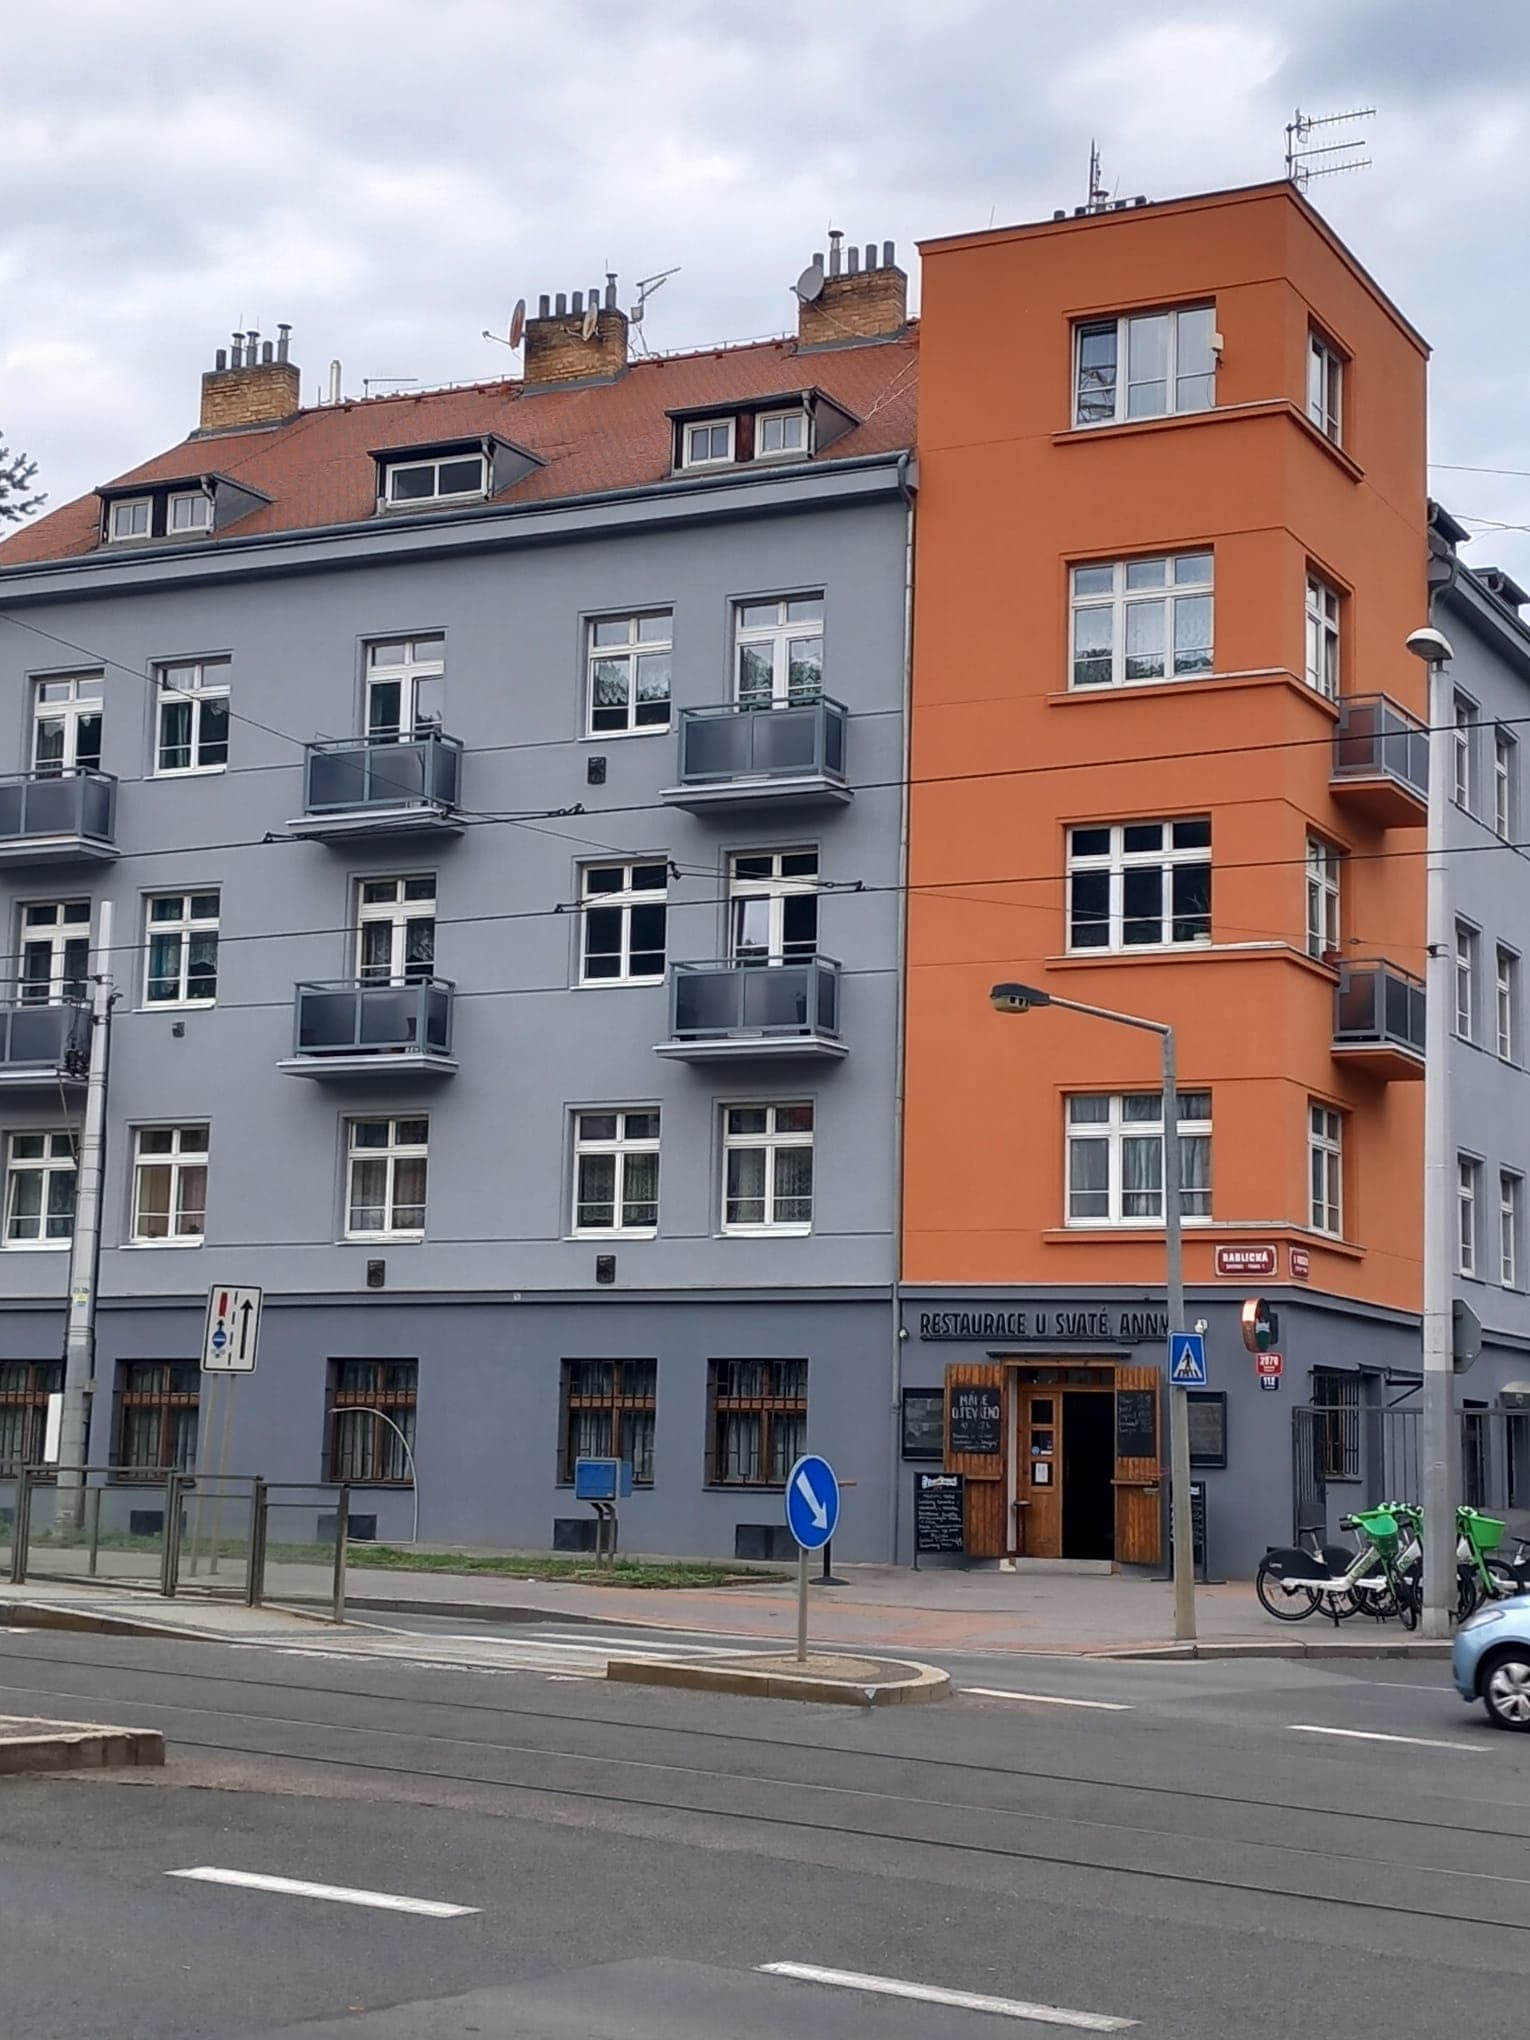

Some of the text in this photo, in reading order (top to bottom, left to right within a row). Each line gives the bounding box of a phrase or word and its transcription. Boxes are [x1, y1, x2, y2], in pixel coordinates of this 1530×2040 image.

[920, 1307, 1170, 1335] RESTAURACE U SVATÉ ANNY
